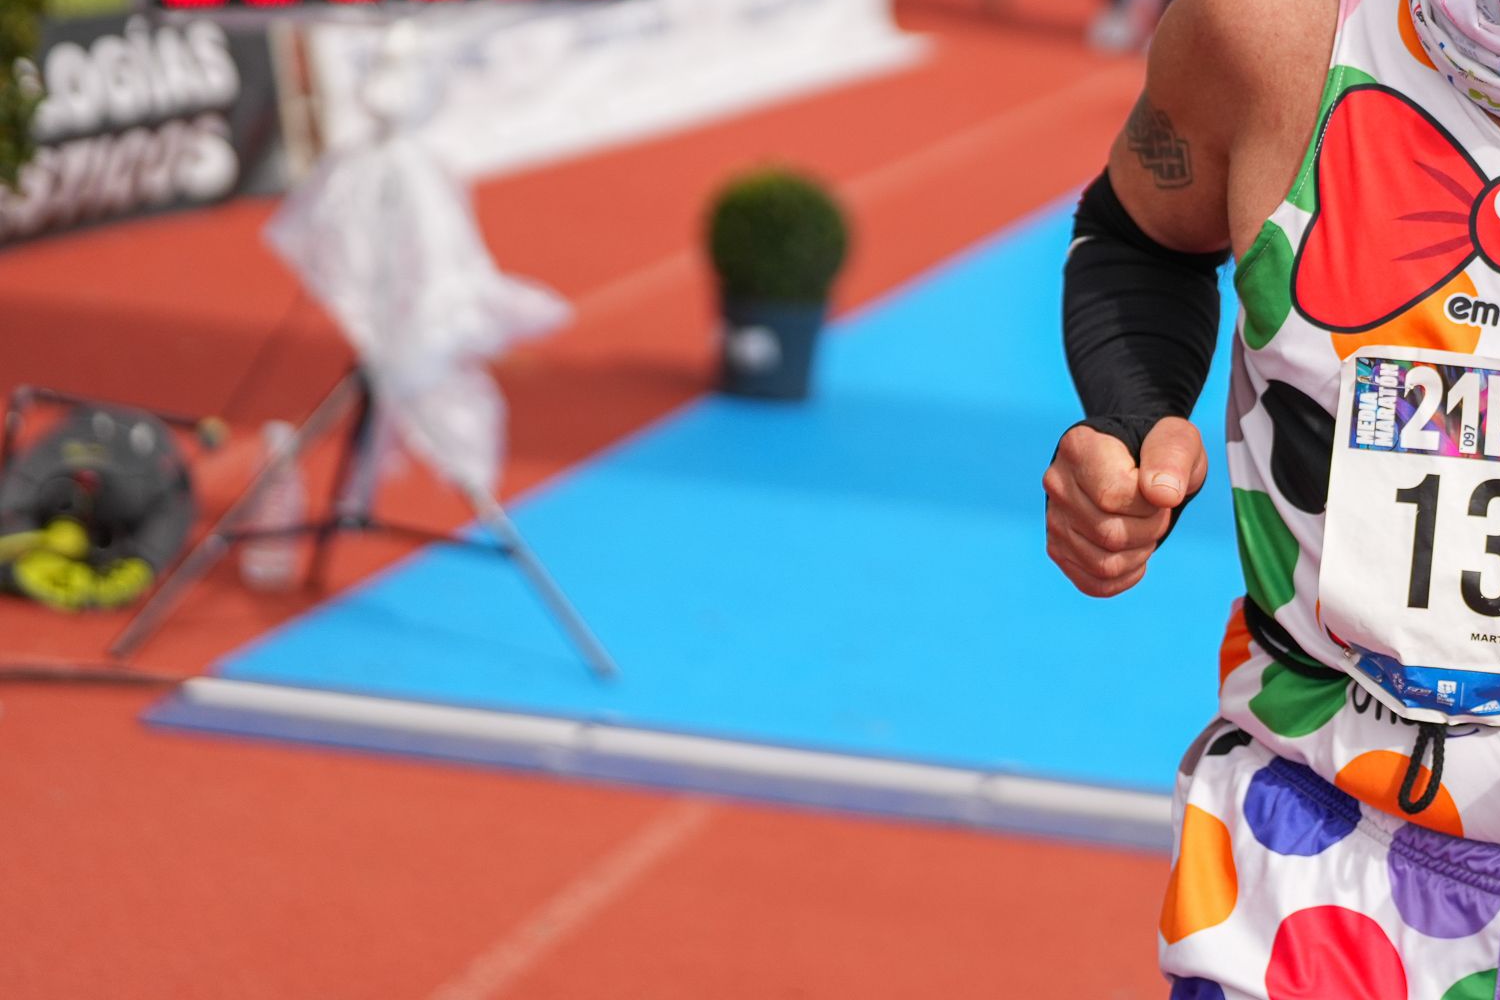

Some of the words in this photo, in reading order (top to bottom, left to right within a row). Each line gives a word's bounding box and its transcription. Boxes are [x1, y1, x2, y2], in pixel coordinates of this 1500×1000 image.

[1355, 391, 1379, 445] MEDIA
[1374, 362, 1400, 447] MARATÓN
[1462, 424, 1476, 448] 097
